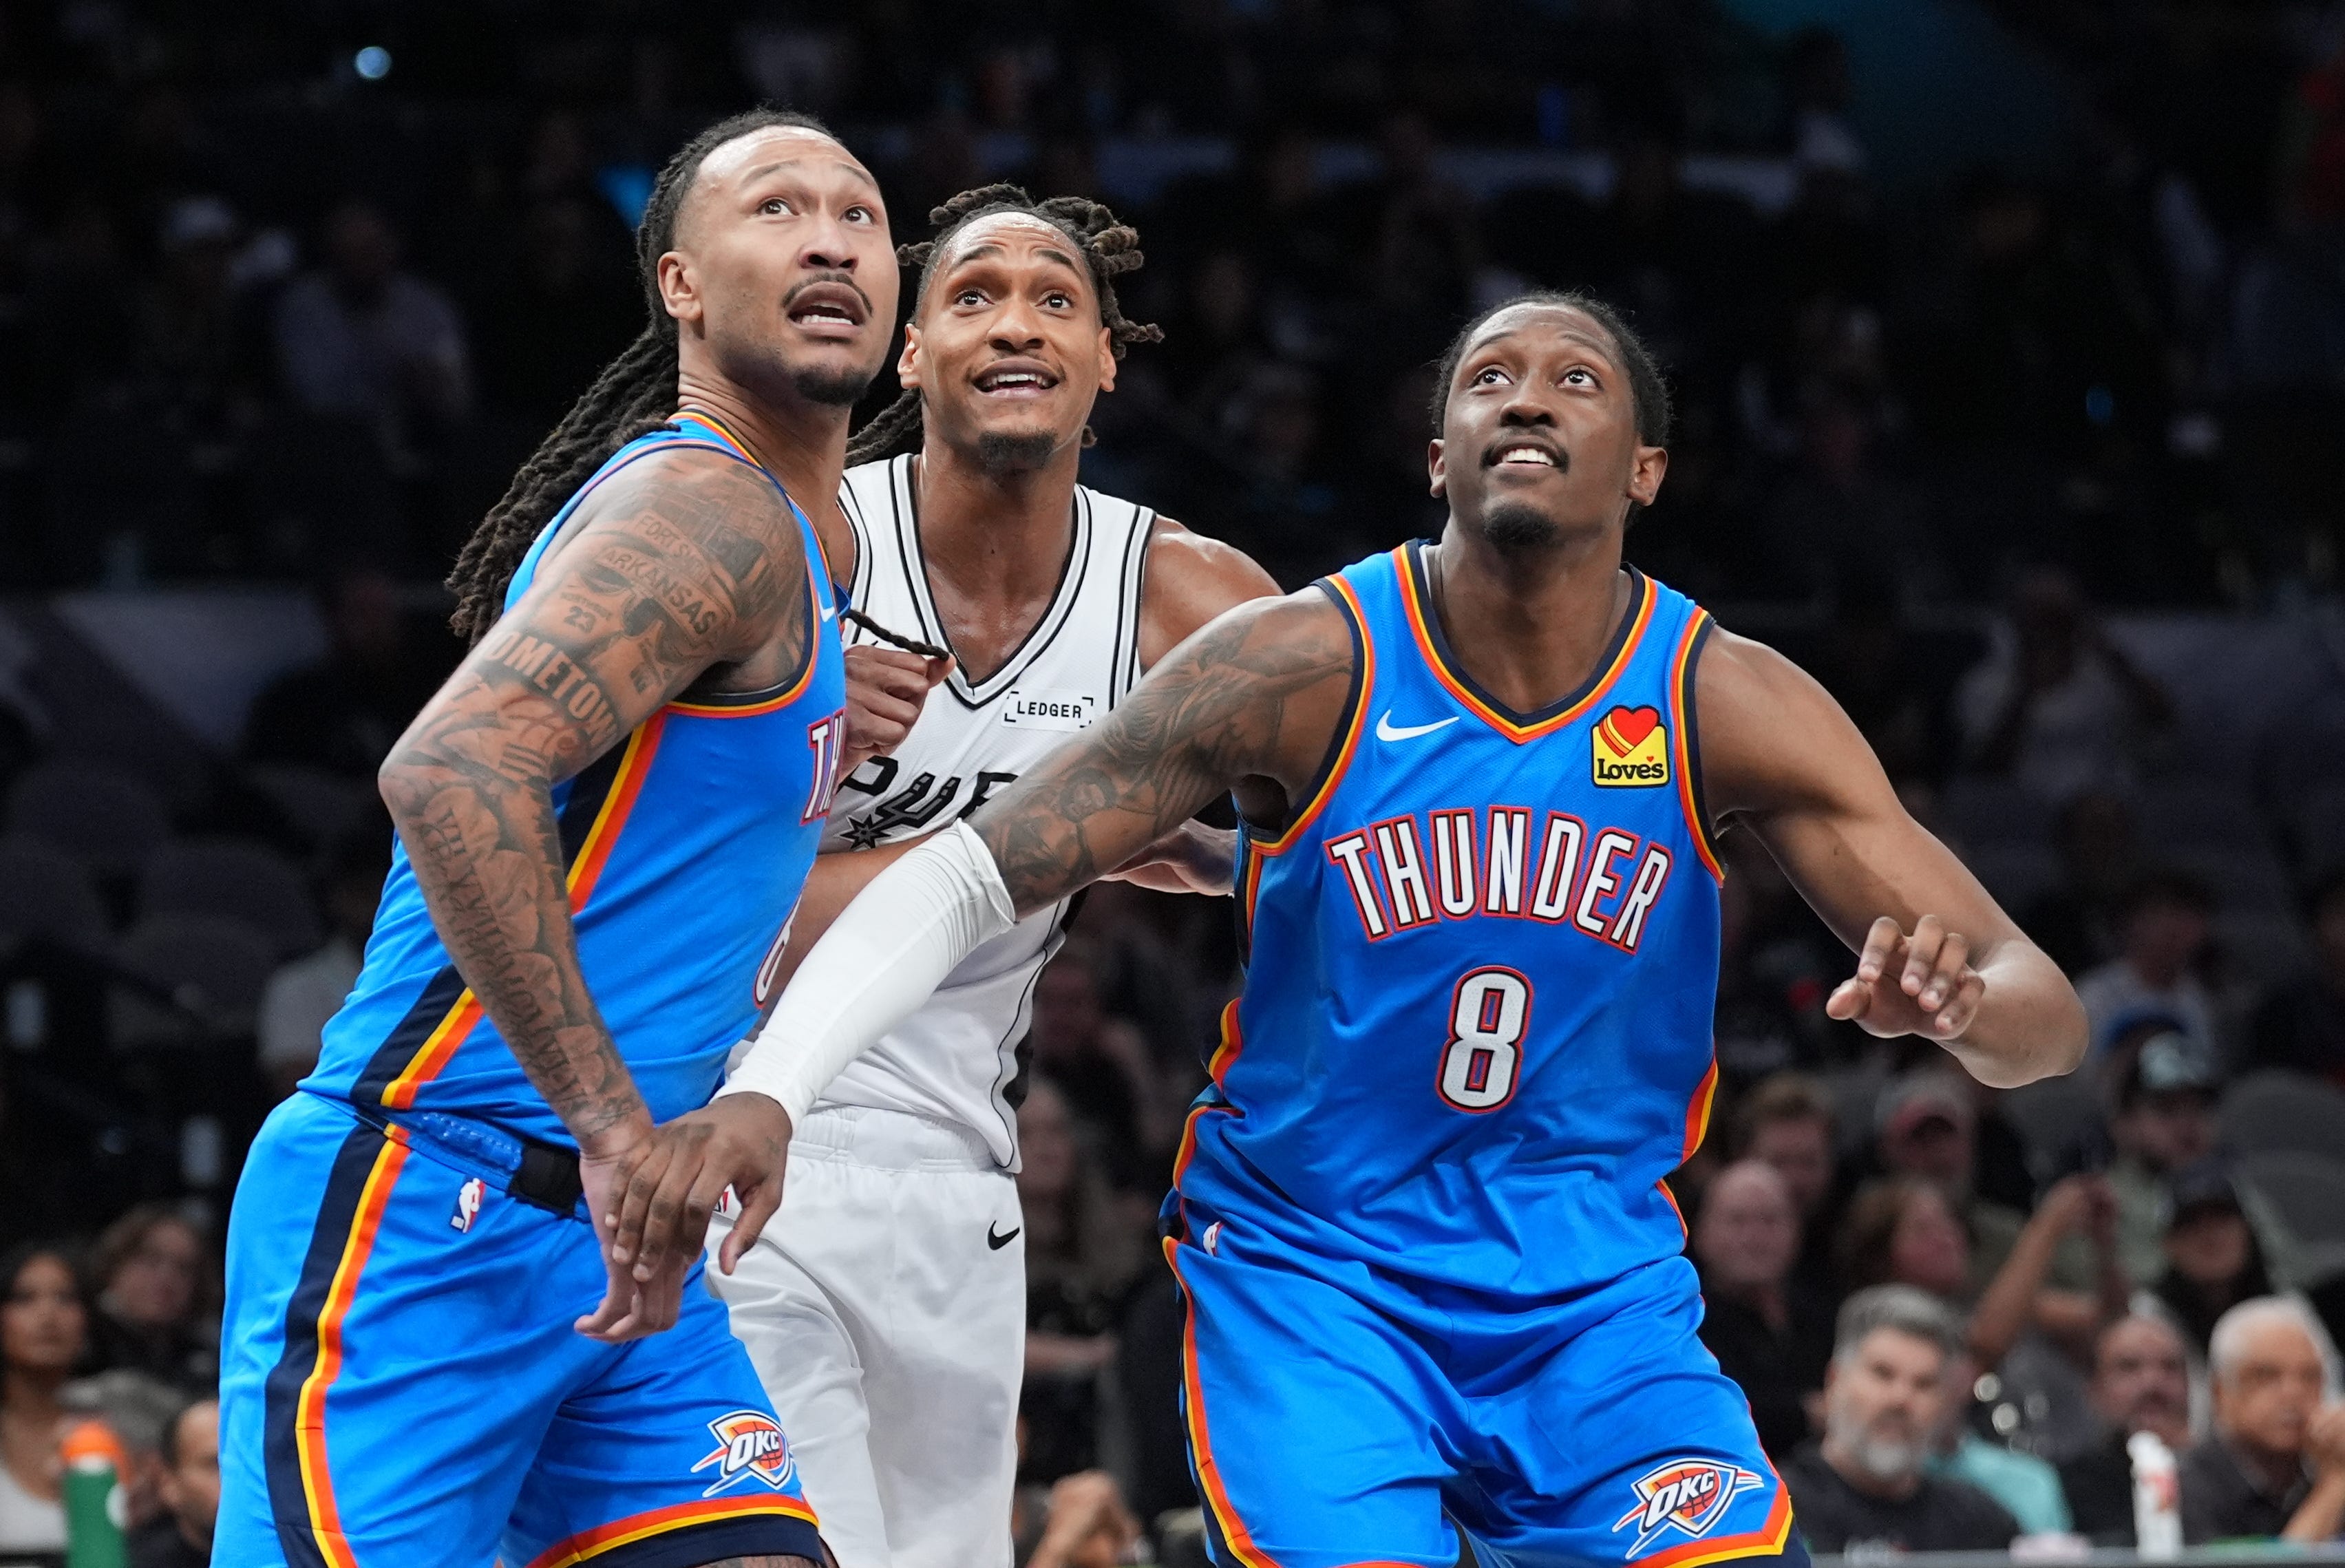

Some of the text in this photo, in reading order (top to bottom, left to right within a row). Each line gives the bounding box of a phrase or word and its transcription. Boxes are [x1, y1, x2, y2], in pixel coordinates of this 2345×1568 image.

[563, 606, 596, 634] 23
[1017, 701, 1081, 719] LEDGER
[1323, 805, 1674, 955] THUNDER
[1435, 965, 1534, 1114] 8
[725, 1429, 780, 1473] OKC
[1645, 1470, 1715, 1528] OKC
